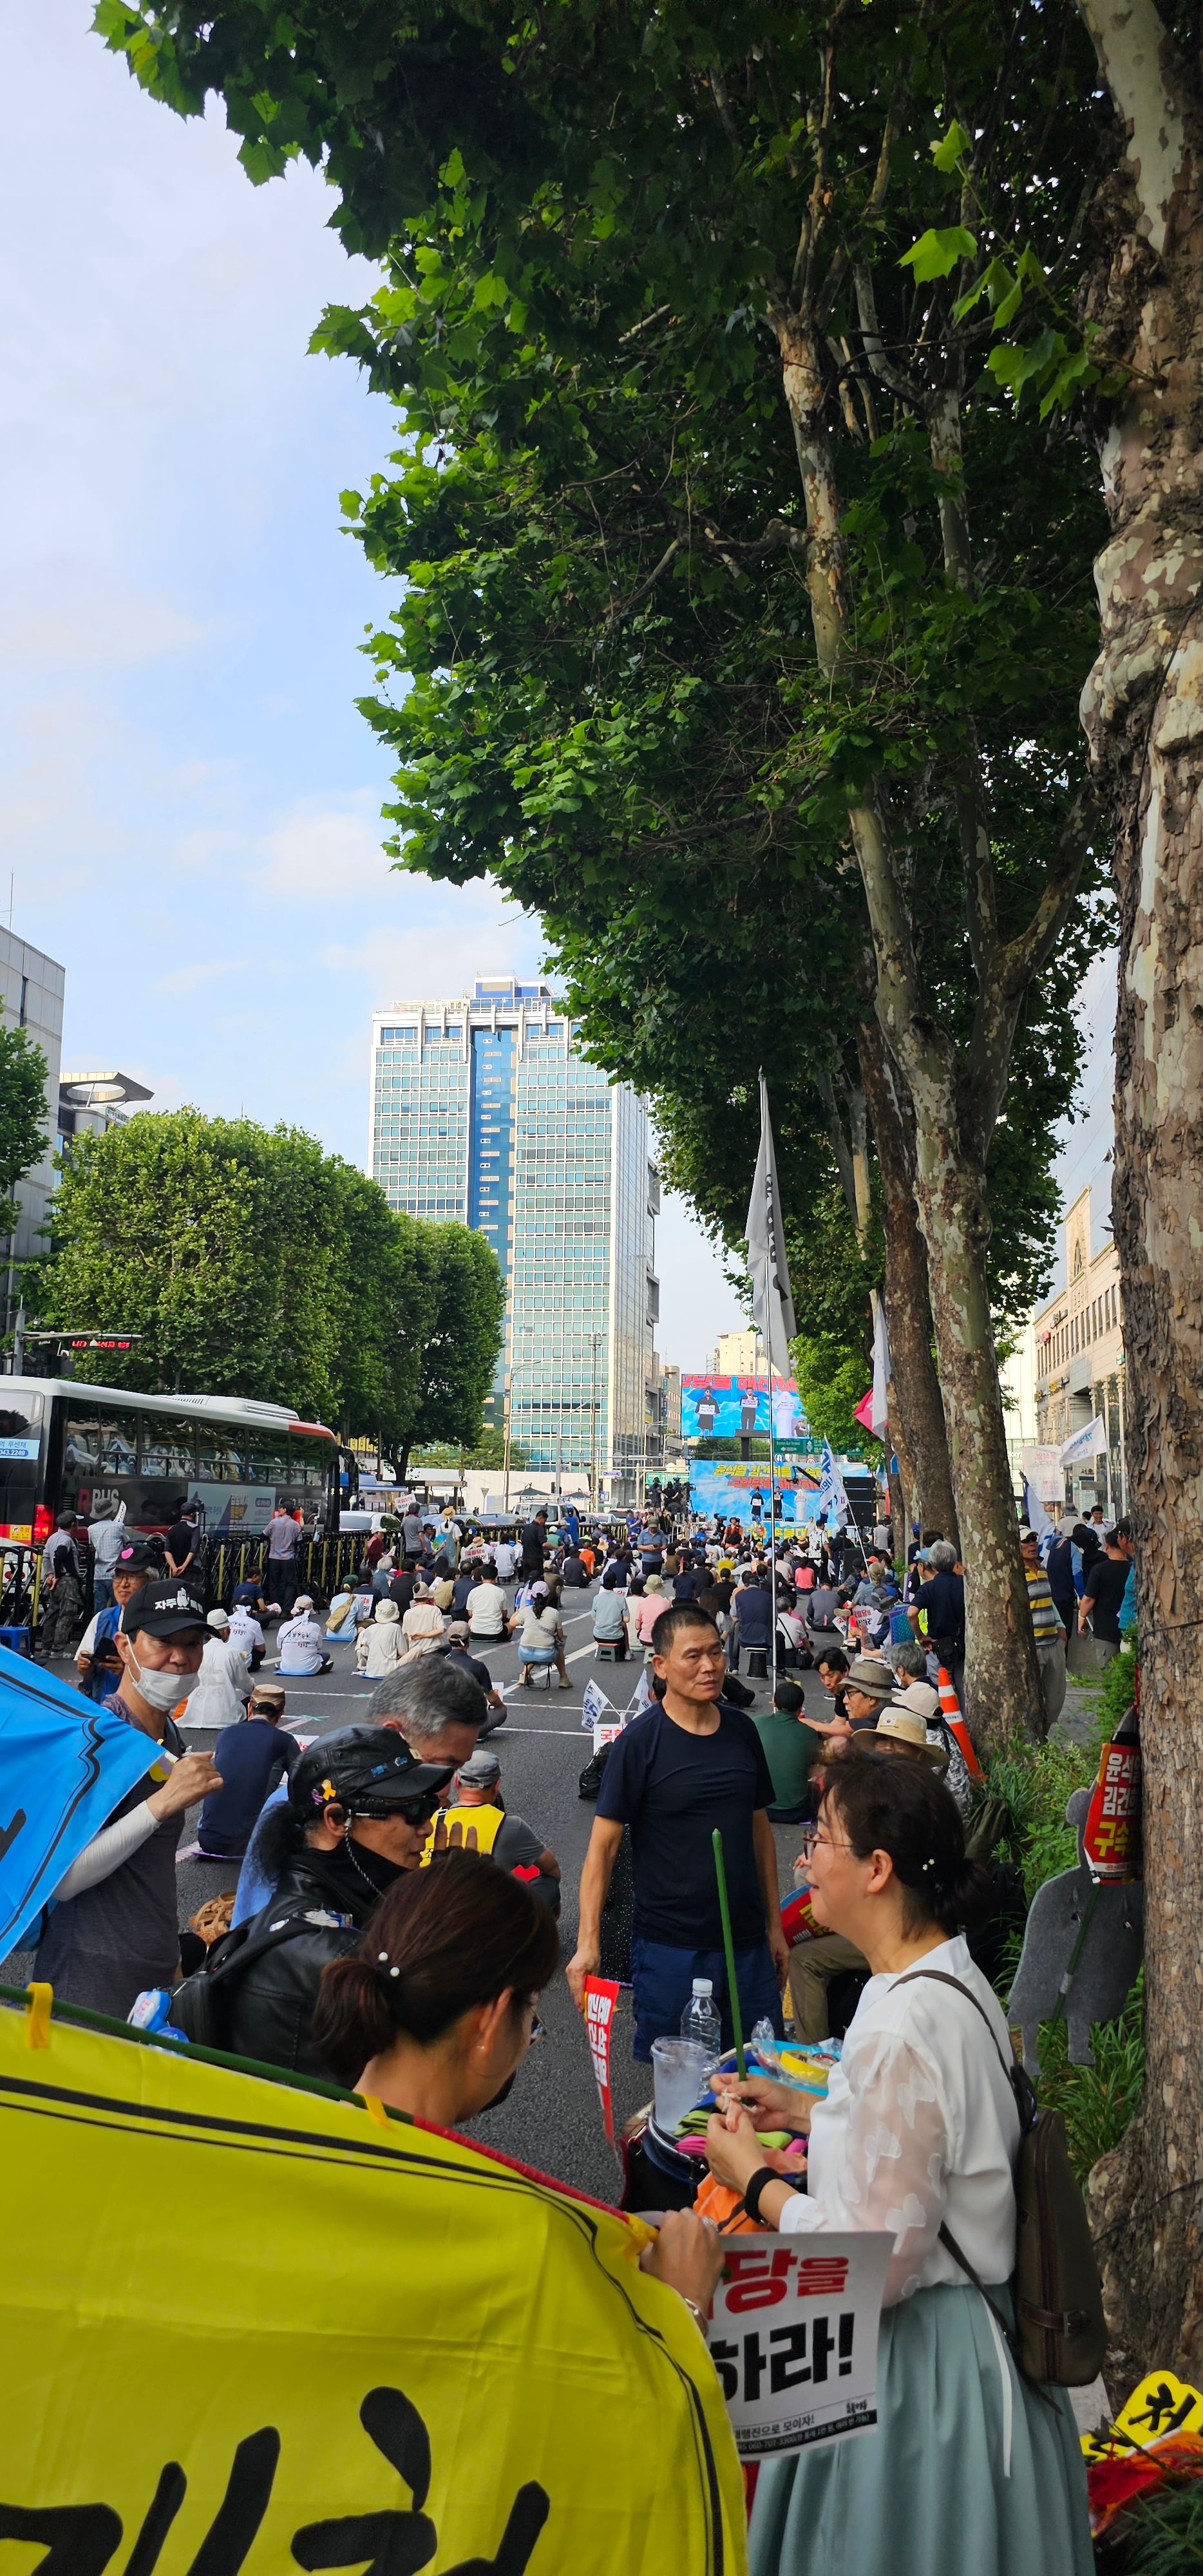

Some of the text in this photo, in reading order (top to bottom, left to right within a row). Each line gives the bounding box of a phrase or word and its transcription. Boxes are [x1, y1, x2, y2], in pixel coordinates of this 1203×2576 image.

[155, 1598, 176, 1610] 자주
[707, 2248, 849, 2318] 당을
[710, 2312, 855, 2402] 하라!
[783, 2414, 815, 2432] 모이자!
